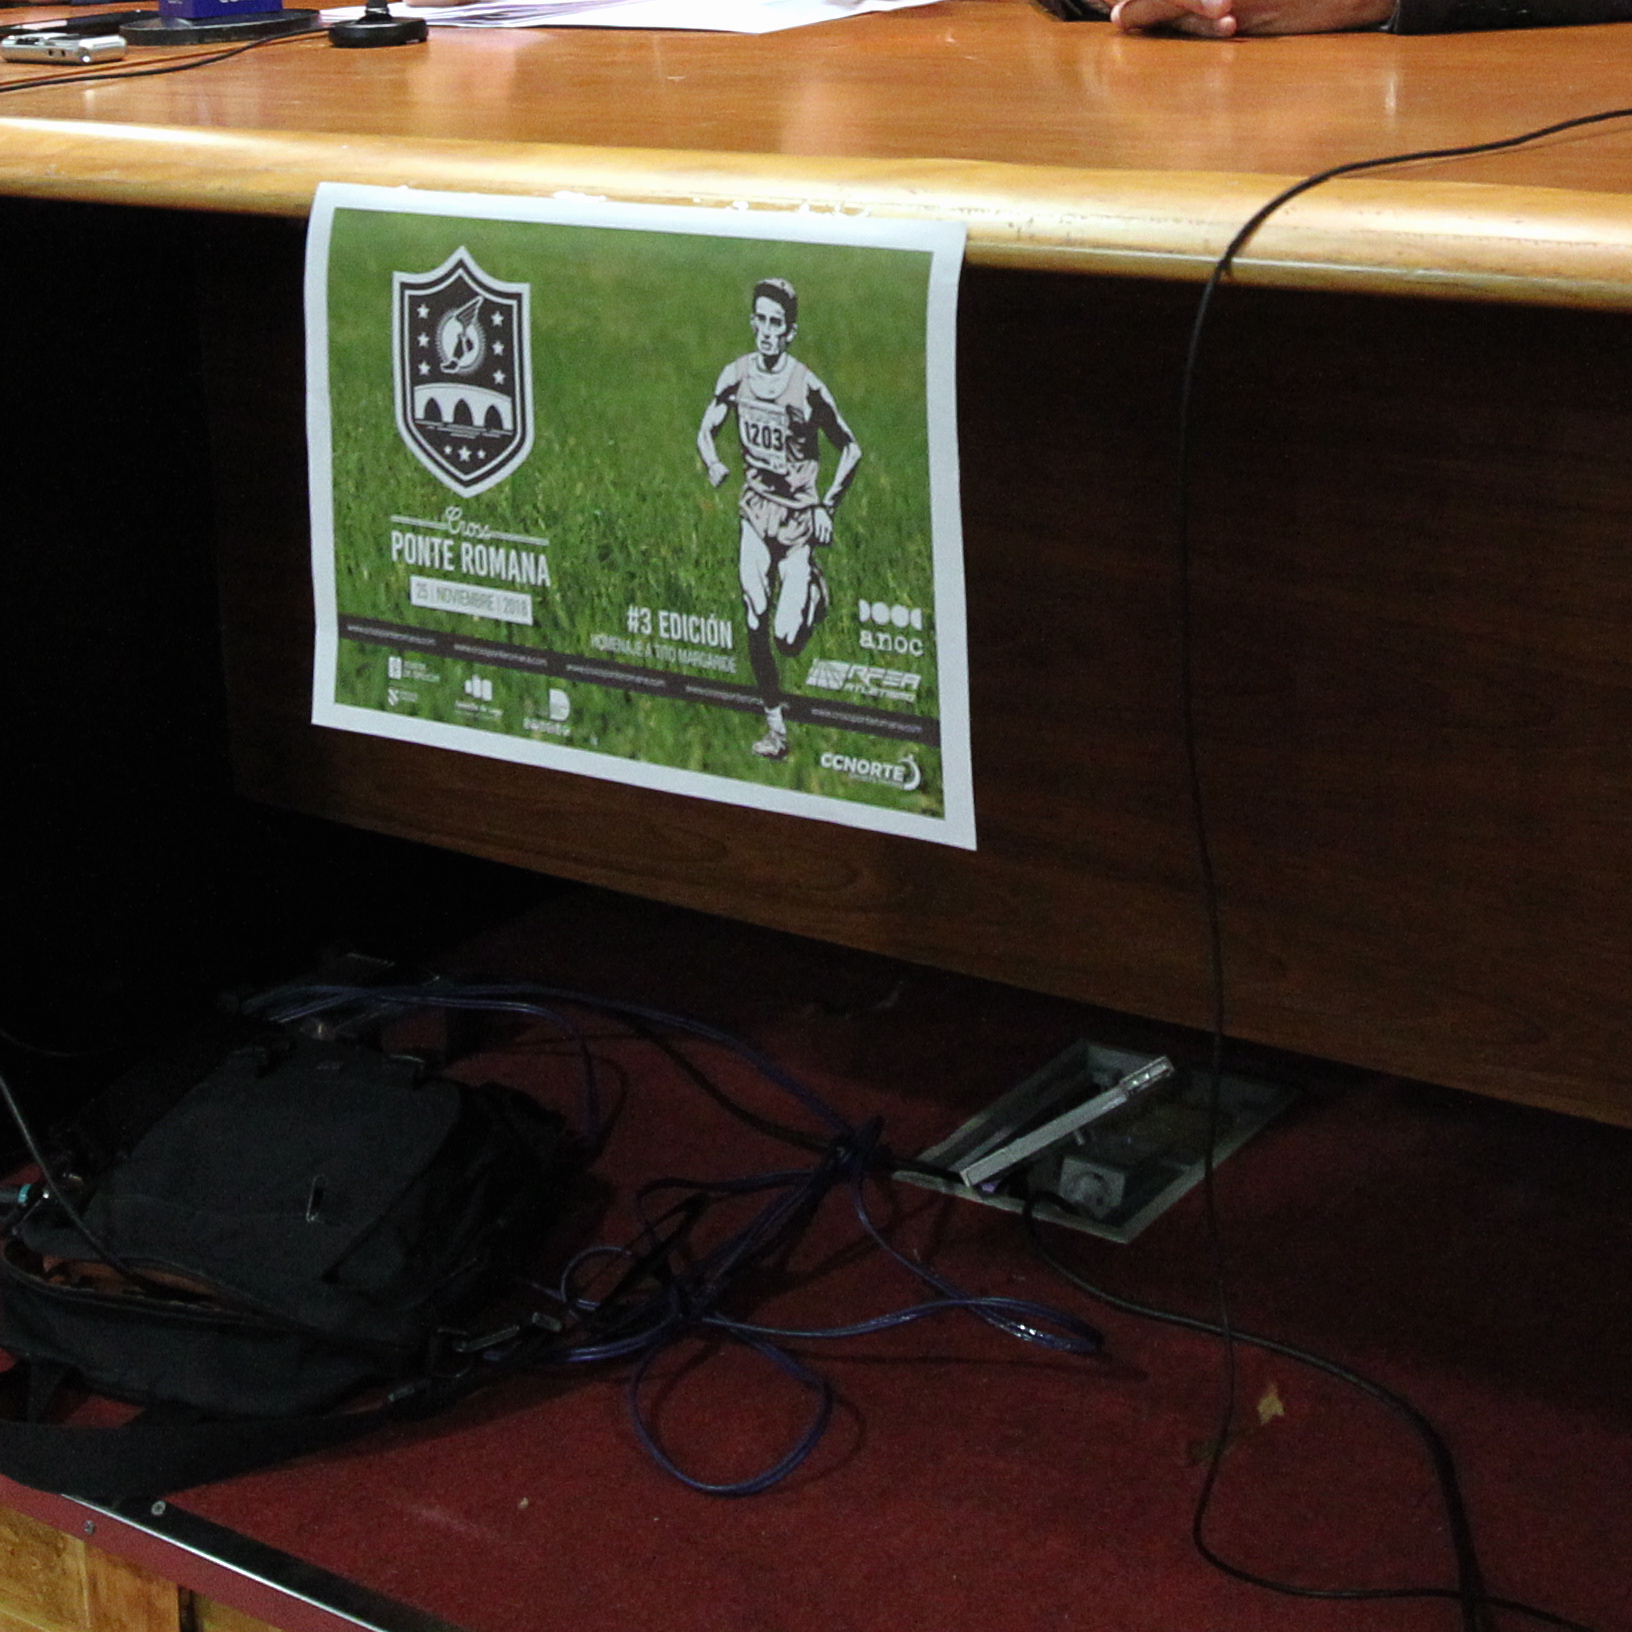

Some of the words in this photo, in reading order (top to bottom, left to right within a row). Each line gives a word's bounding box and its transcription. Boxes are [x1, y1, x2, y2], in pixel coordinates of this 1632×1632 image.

[744, 421, 784, 452] 1203
[391, 530, 455, 572] PONTE
[460, 541, 552, 588] ROMANA
[626, 603, 653, 635] #3
[657, 609, 734, 650] EDICIÓN
[859, 629, 924, 657] anoc
[820, 751, 906, 783] CCNORTE
